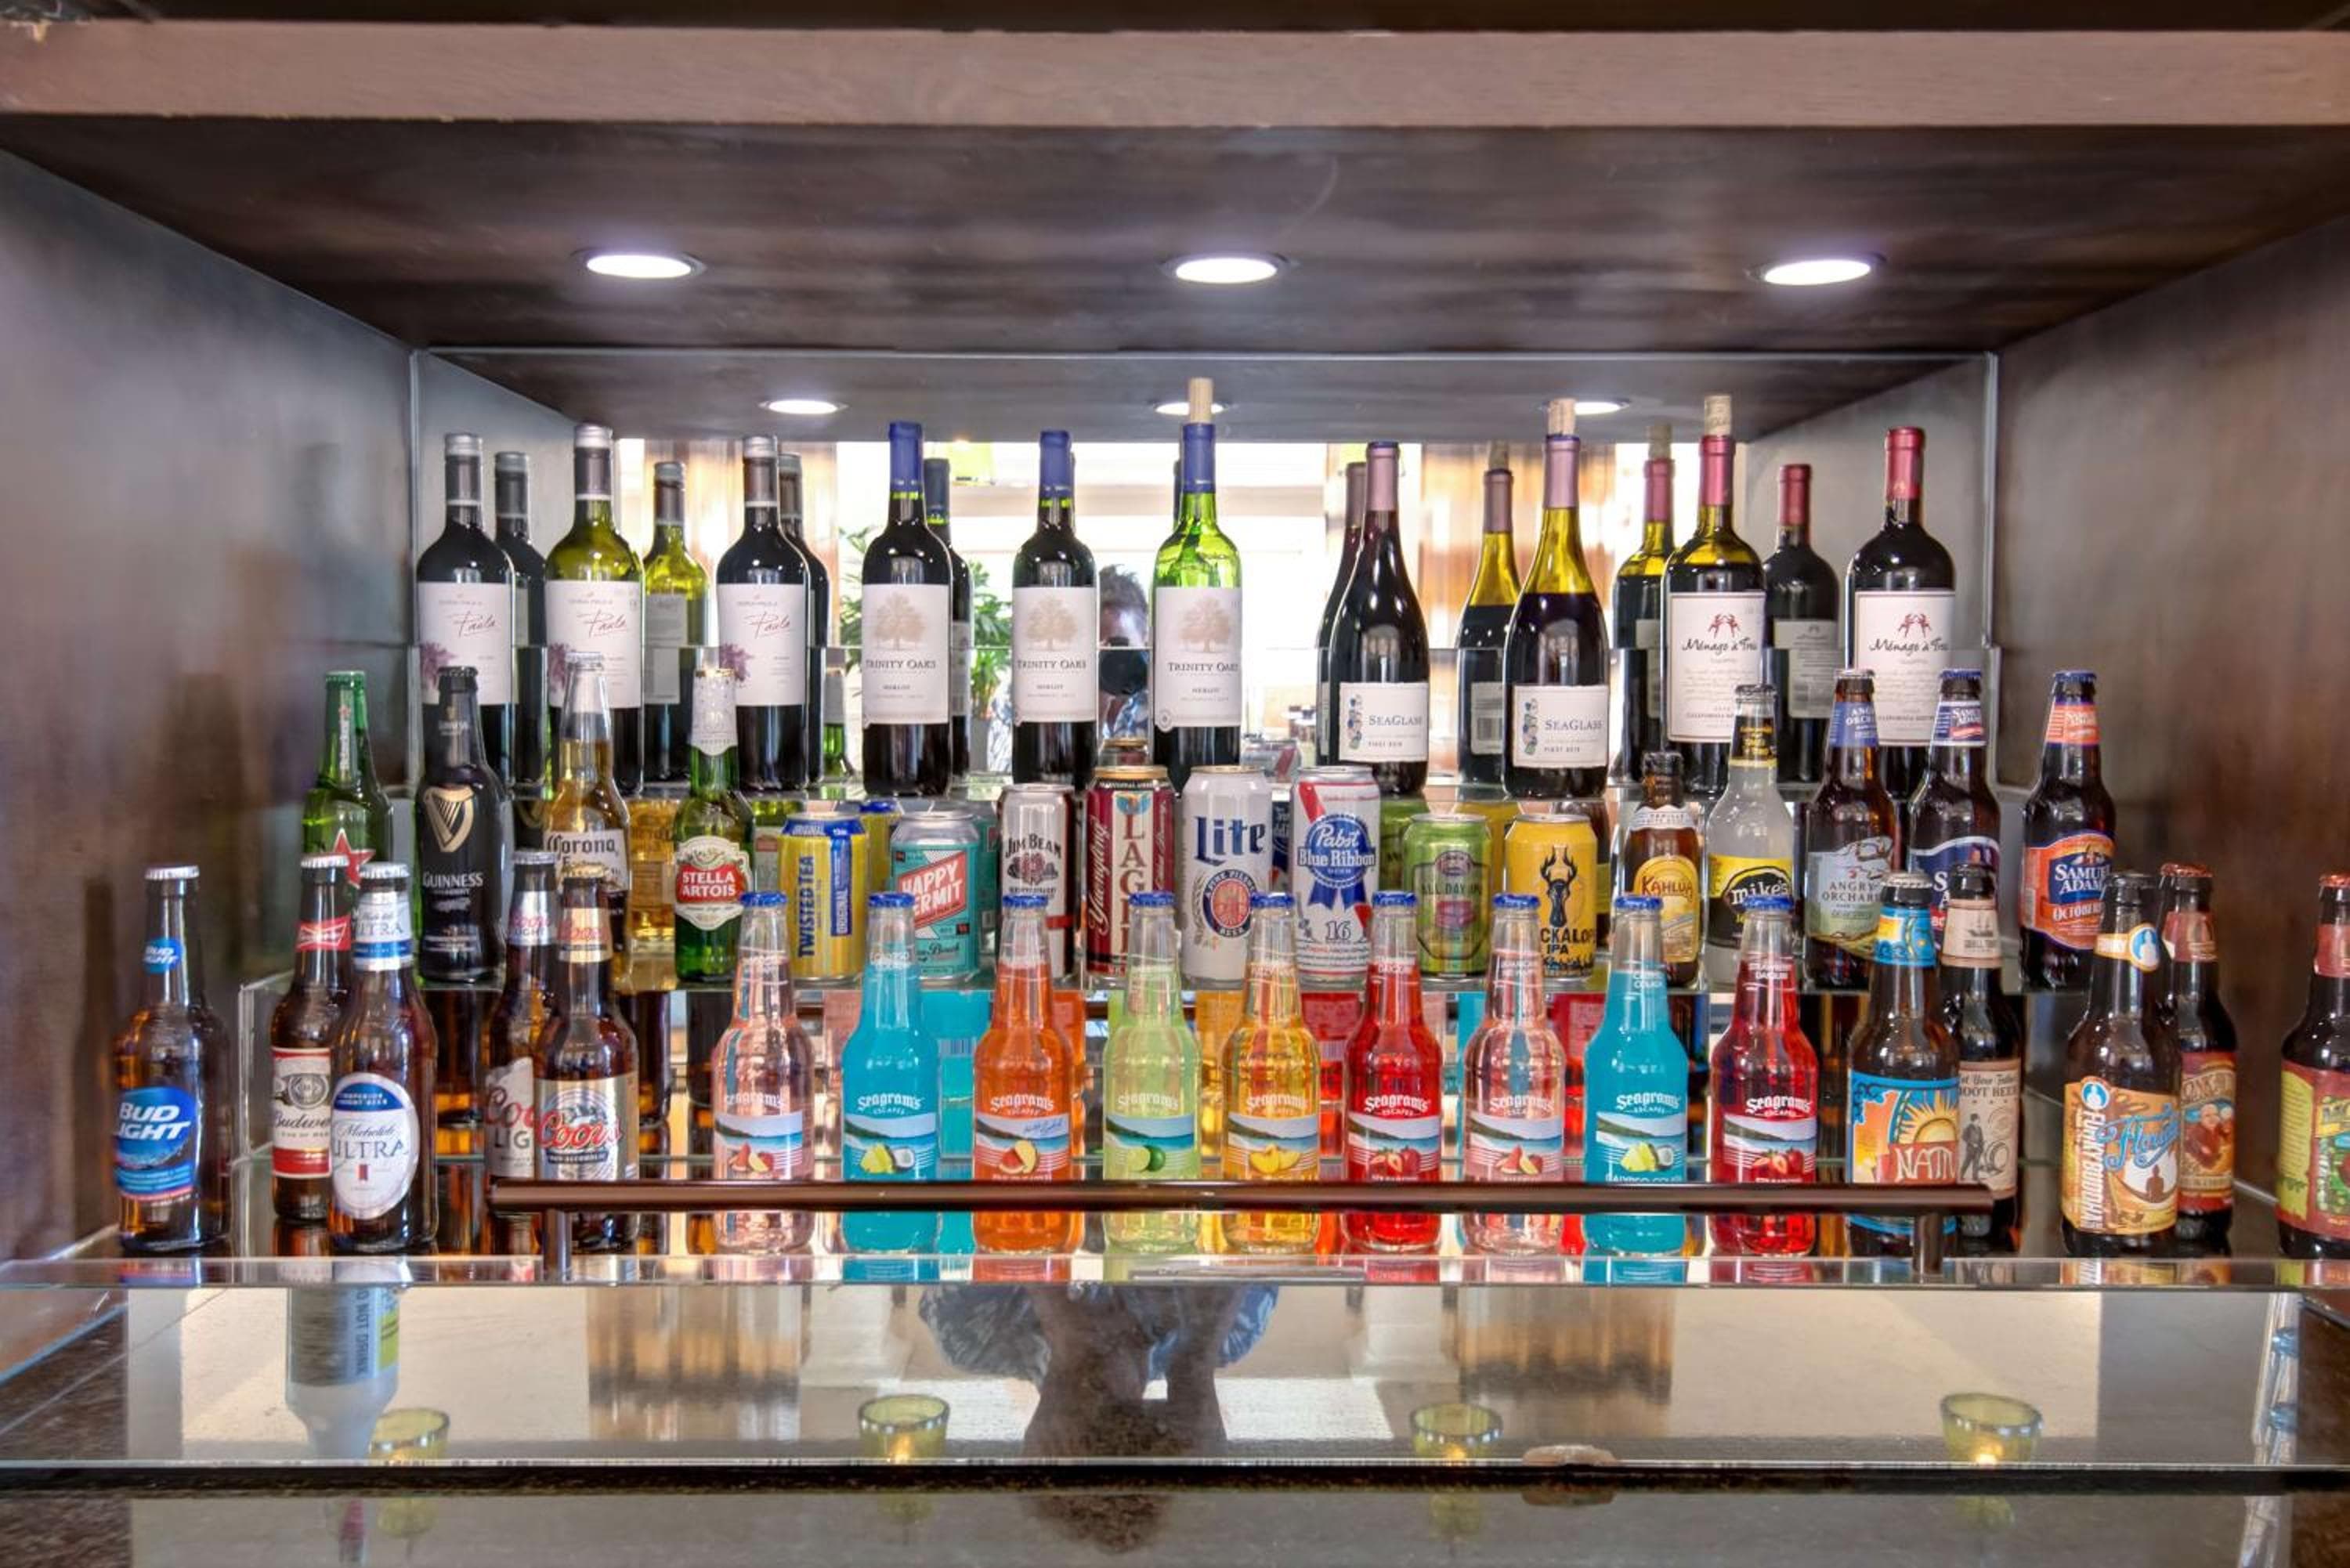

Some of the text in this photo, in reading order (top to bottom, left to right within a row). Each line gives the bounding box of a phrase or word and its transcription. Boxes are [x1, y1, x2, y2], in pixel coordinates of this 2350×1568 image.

[1005, 833, 1061, 858] JIM BEAM
[1195, 815, 1267, 866] Lite
[1317, 823, 1360, 847] Pabst
[548, 834, 616, 860] Corona
[1298, 847, 1376, 866] Blue Ribbon
[423, 871, 483, 887] GUINNESS
[683, 871, 736, 884] STELLA
[902, 860, 959, 894] HAPPY
[1830, 881, 1875, 891] ANGRY
[2059, 879, 2105, 894] ADAM
[682, 884, 736, 897] ARTOIS
[913, 879, 963, 916] ERMIT
[797, 855, 815, 958] TWISTED TEA
[1326, 920, 1351, 940] 16
[1546, 945, 1569, 954] IPA
[119, 1102, 181, 1122] BUD
[486, 1086, 535, 1129] Coo
[494, 1128, 531, 1150] LIG
[537, 1109, 622, 1150] Coors
